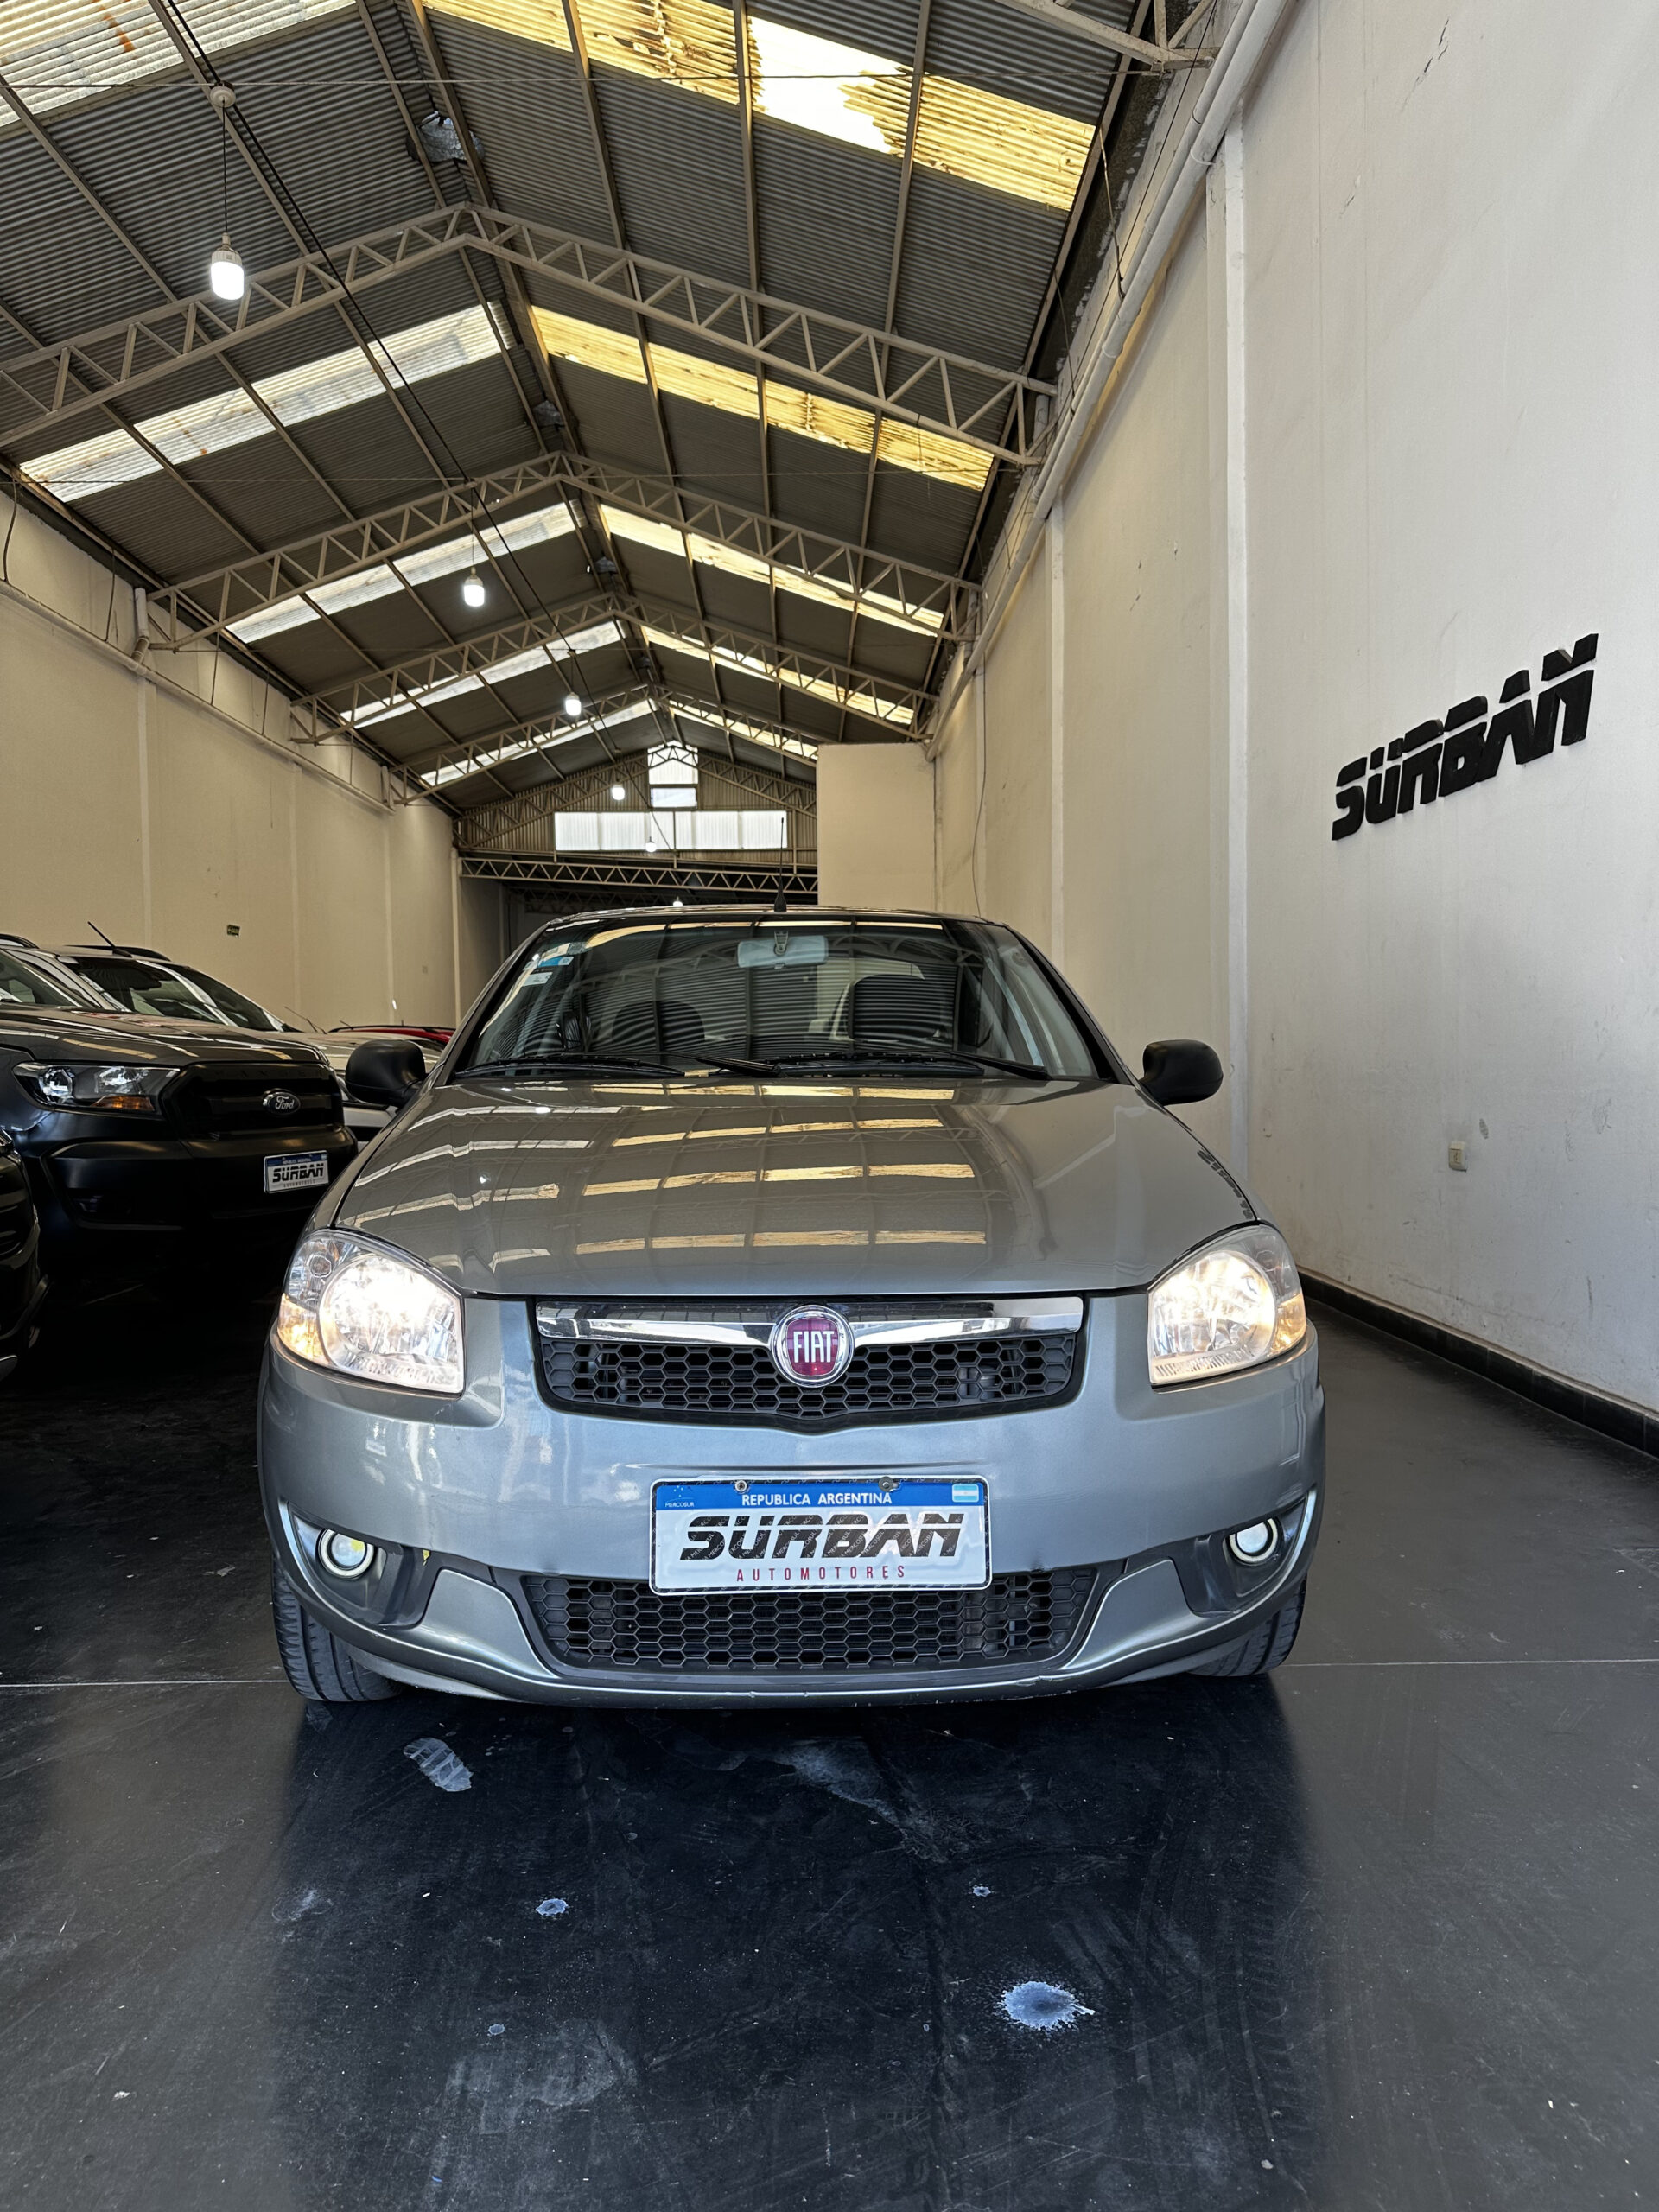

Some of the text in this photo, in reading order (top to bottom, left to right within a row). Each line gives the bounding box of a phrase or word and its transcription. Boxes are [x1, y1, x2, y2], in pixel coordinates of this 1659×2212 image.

[1332, 633, 1599, 841] SURBAN
[275, 1096, 295, 1110] Ford
[272, 1162, 324, 1183] SURBAN
[793, 1330, 835, 1363] FIAT
[741, 1492, 893, 1506] REPUBLICA ARGENTINA
[679, 1513, 964, 1560] SURBAN
[736, 1565, 905, 1582] AUTOMOTORES
